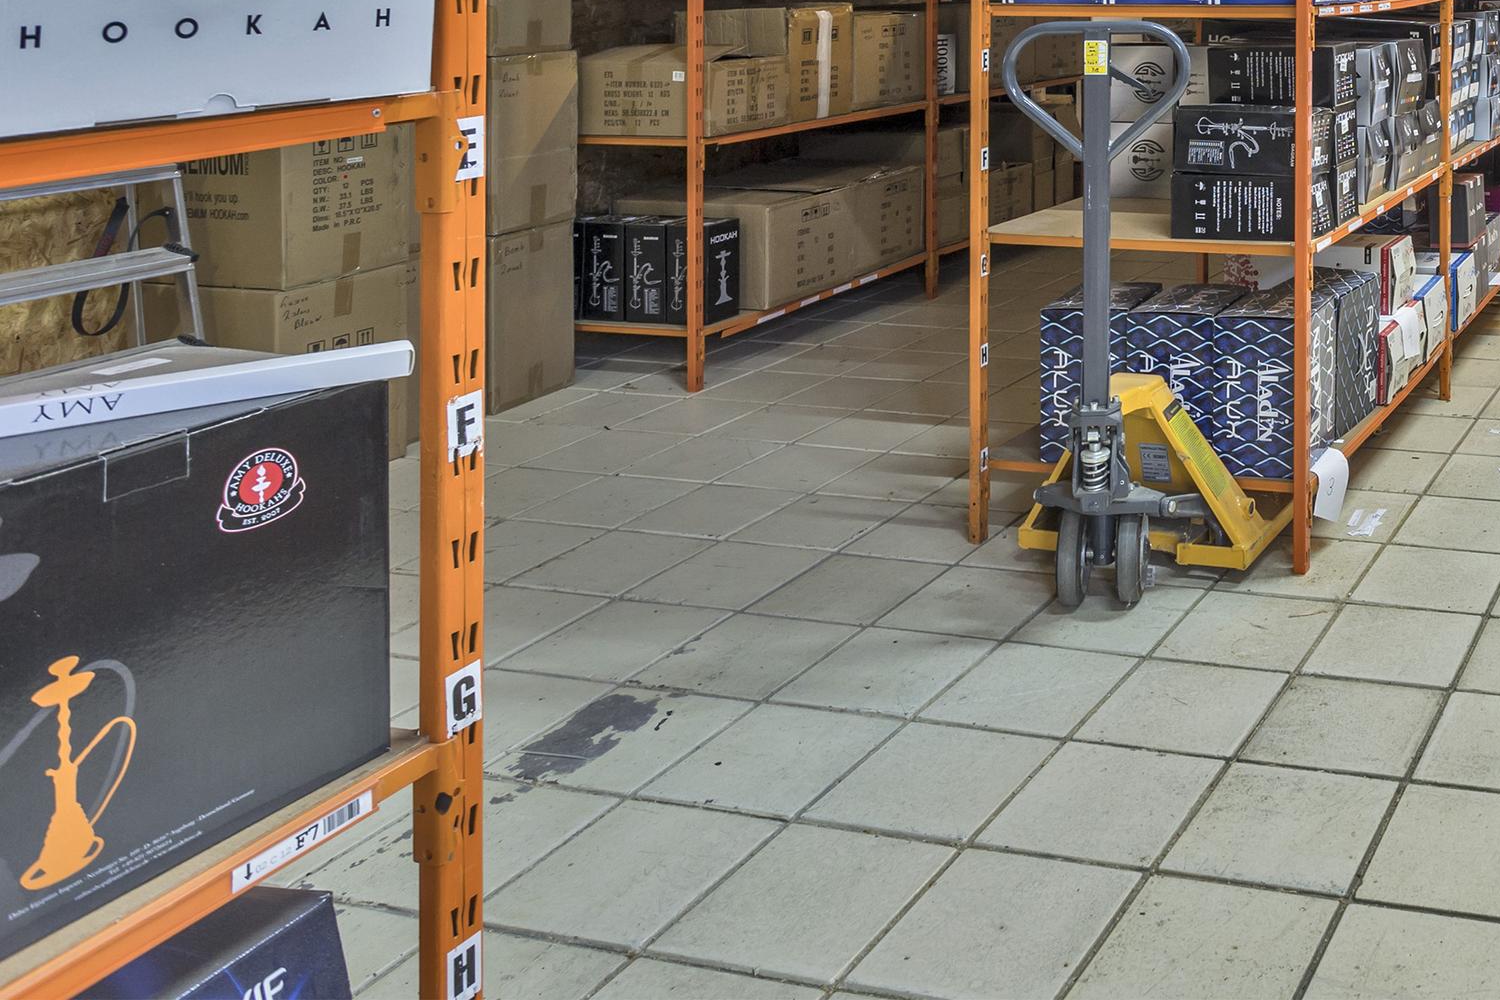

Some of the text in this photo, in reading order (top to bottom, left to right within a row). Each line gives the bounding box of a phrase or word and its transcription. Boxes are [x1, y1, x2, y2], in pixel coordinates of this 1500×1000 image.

[20, 8, 392, 49] HOOKAH
[710, 230, 738, 245] HOOKAH
[33, 392, 124, 423] AMY
[456, 403, 475, 446] F
[230, 452, 293, 489] AMY DELUXE
[235, 488, 287, 513] HOOKAHS
[452, 675, 476, 721] G
[295, 823, 319, 851] F7
[454, 944, 475, 998] H
